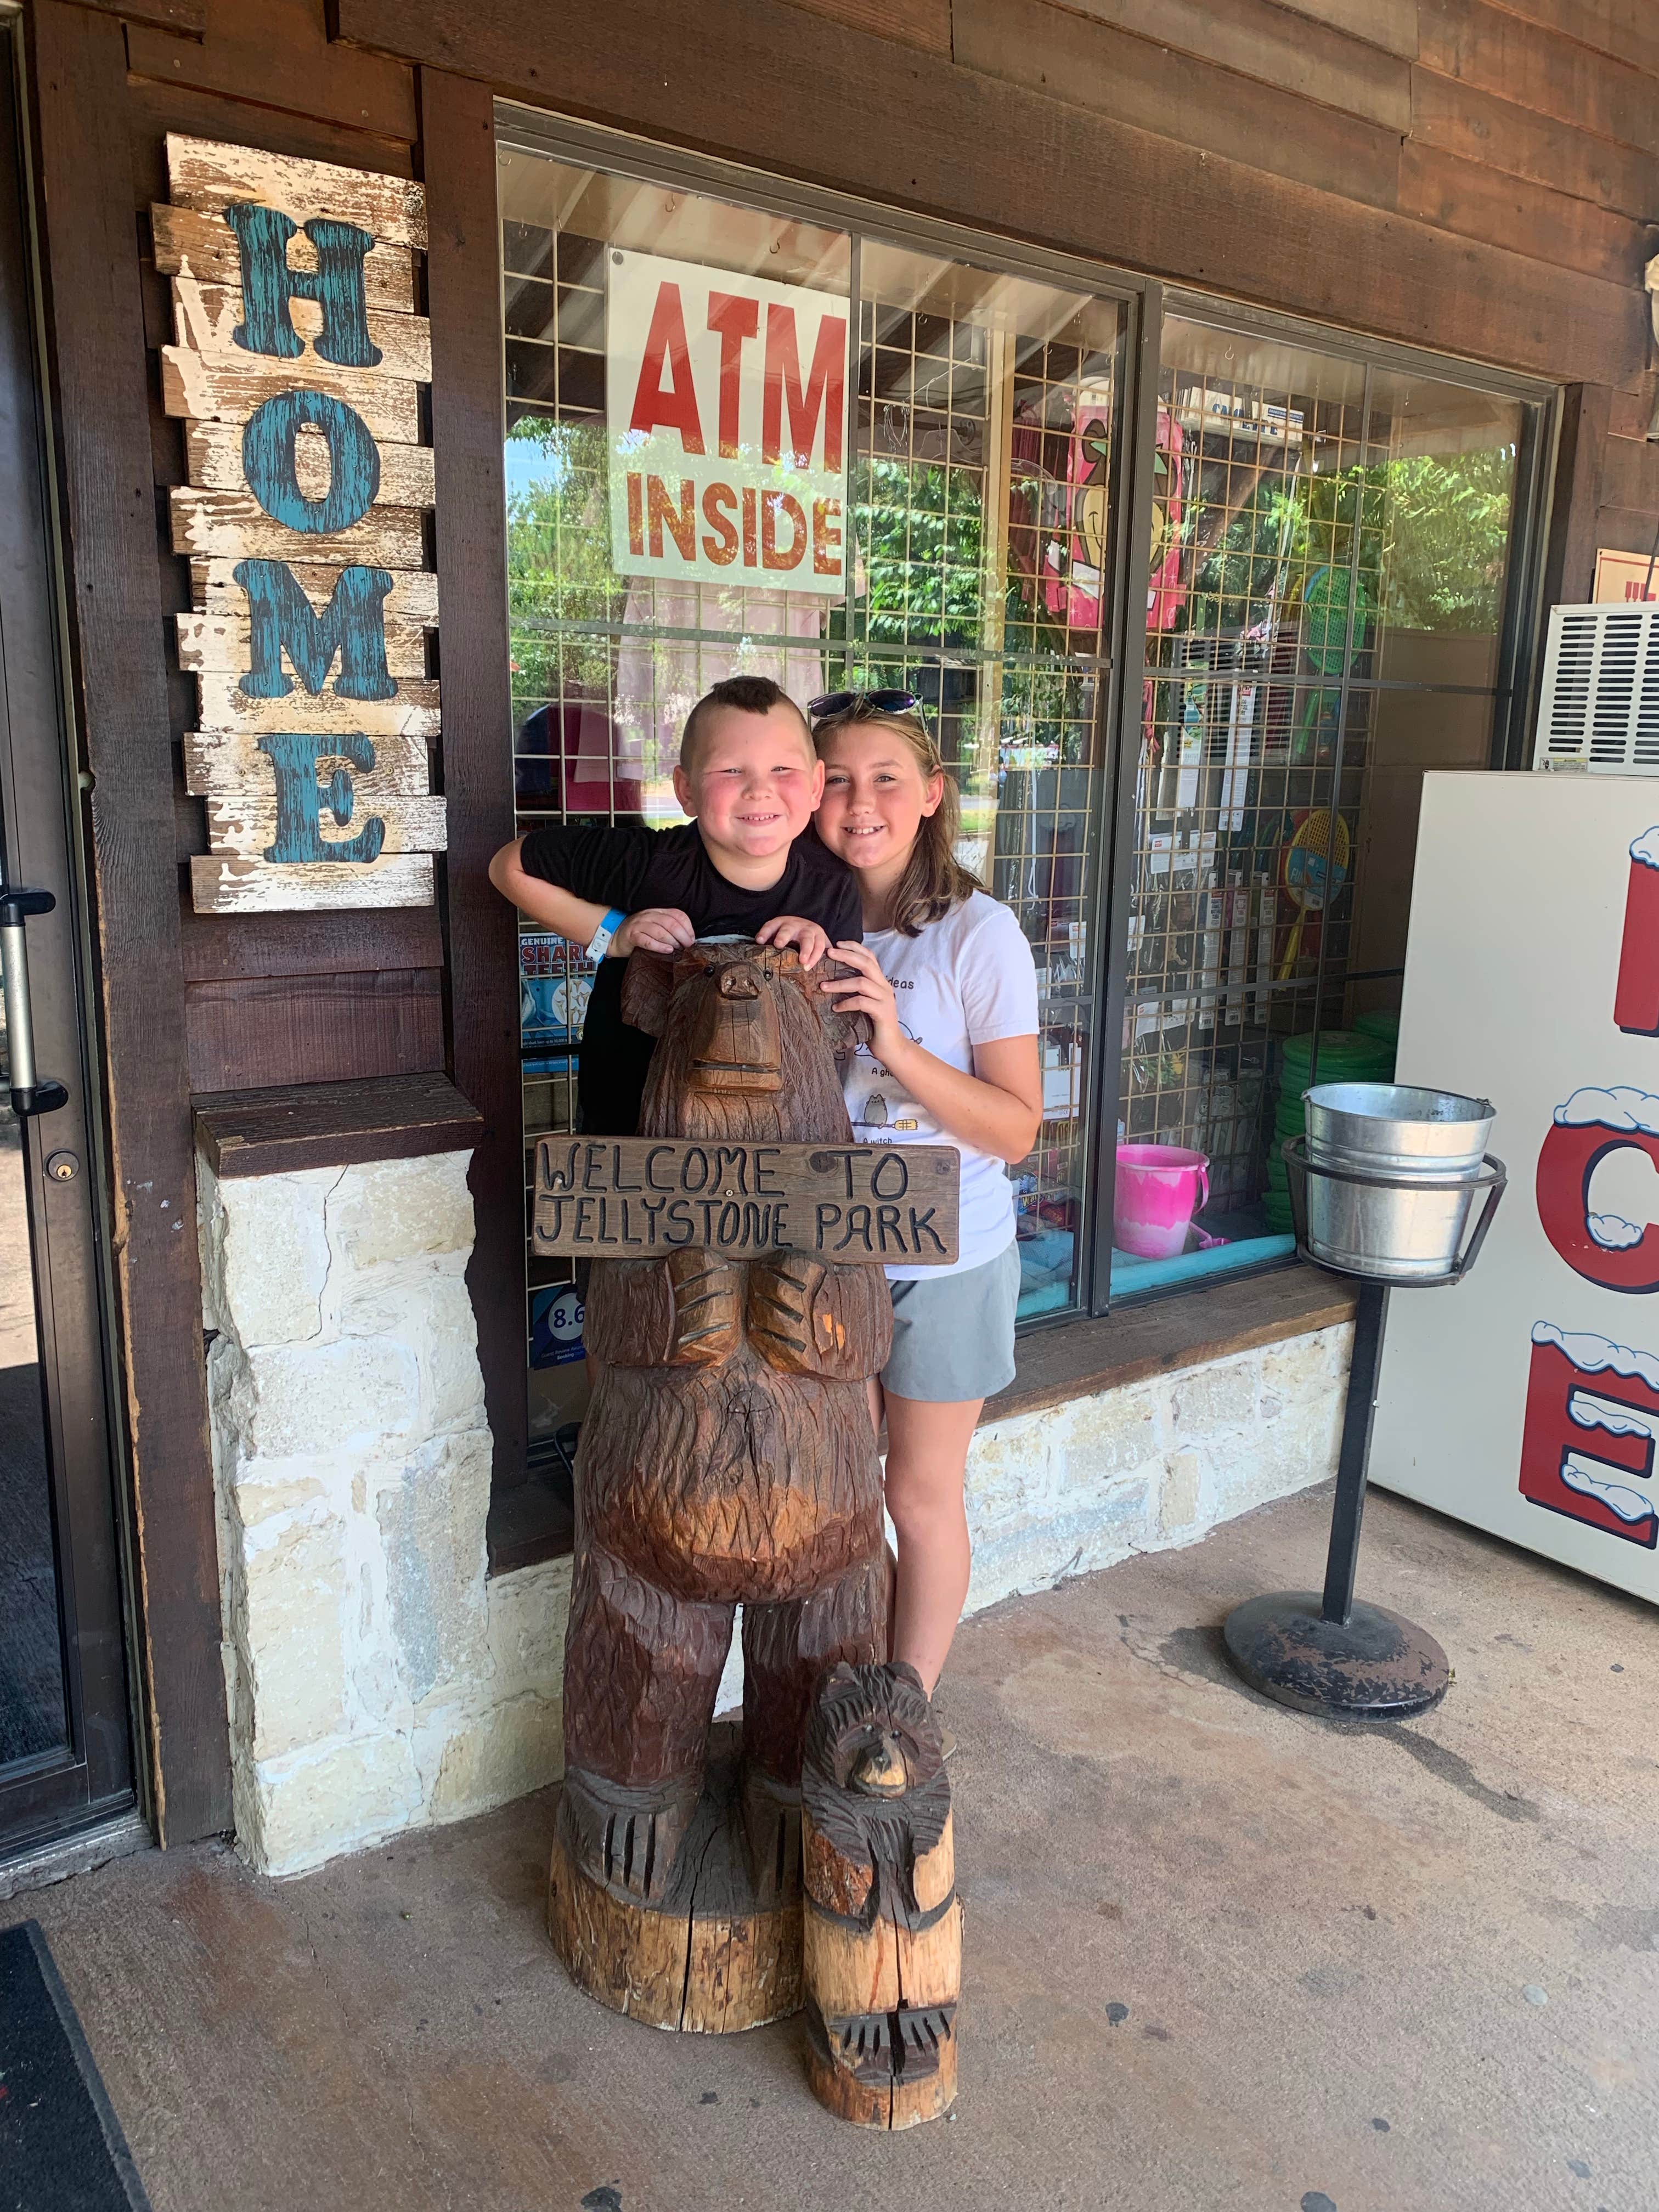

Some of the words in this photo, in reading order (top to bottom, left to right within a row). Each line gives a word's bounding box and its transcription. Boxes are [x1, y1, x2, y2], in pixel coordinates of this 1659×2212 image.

[627, 281, 847, 474] ATM
[221, 203, 398, 864] HOME
[627, 471, 842, 575] INSIDE
[521, 936, 563, 946] GENUINE
[523, 961, 594, 982] TEETH
[871, 1067, 878, 1075] A
[871, 1137, 893, 1145] witch
[541, 1142, 785, 1197] WELCOME
[826, 1149, 909, 1201] TO
[535, 1194, 793, 1249] JELLYSTONE
[816, 1204, 947, 1254] PARK
[553, 1305, 585, 1328] 8.6
